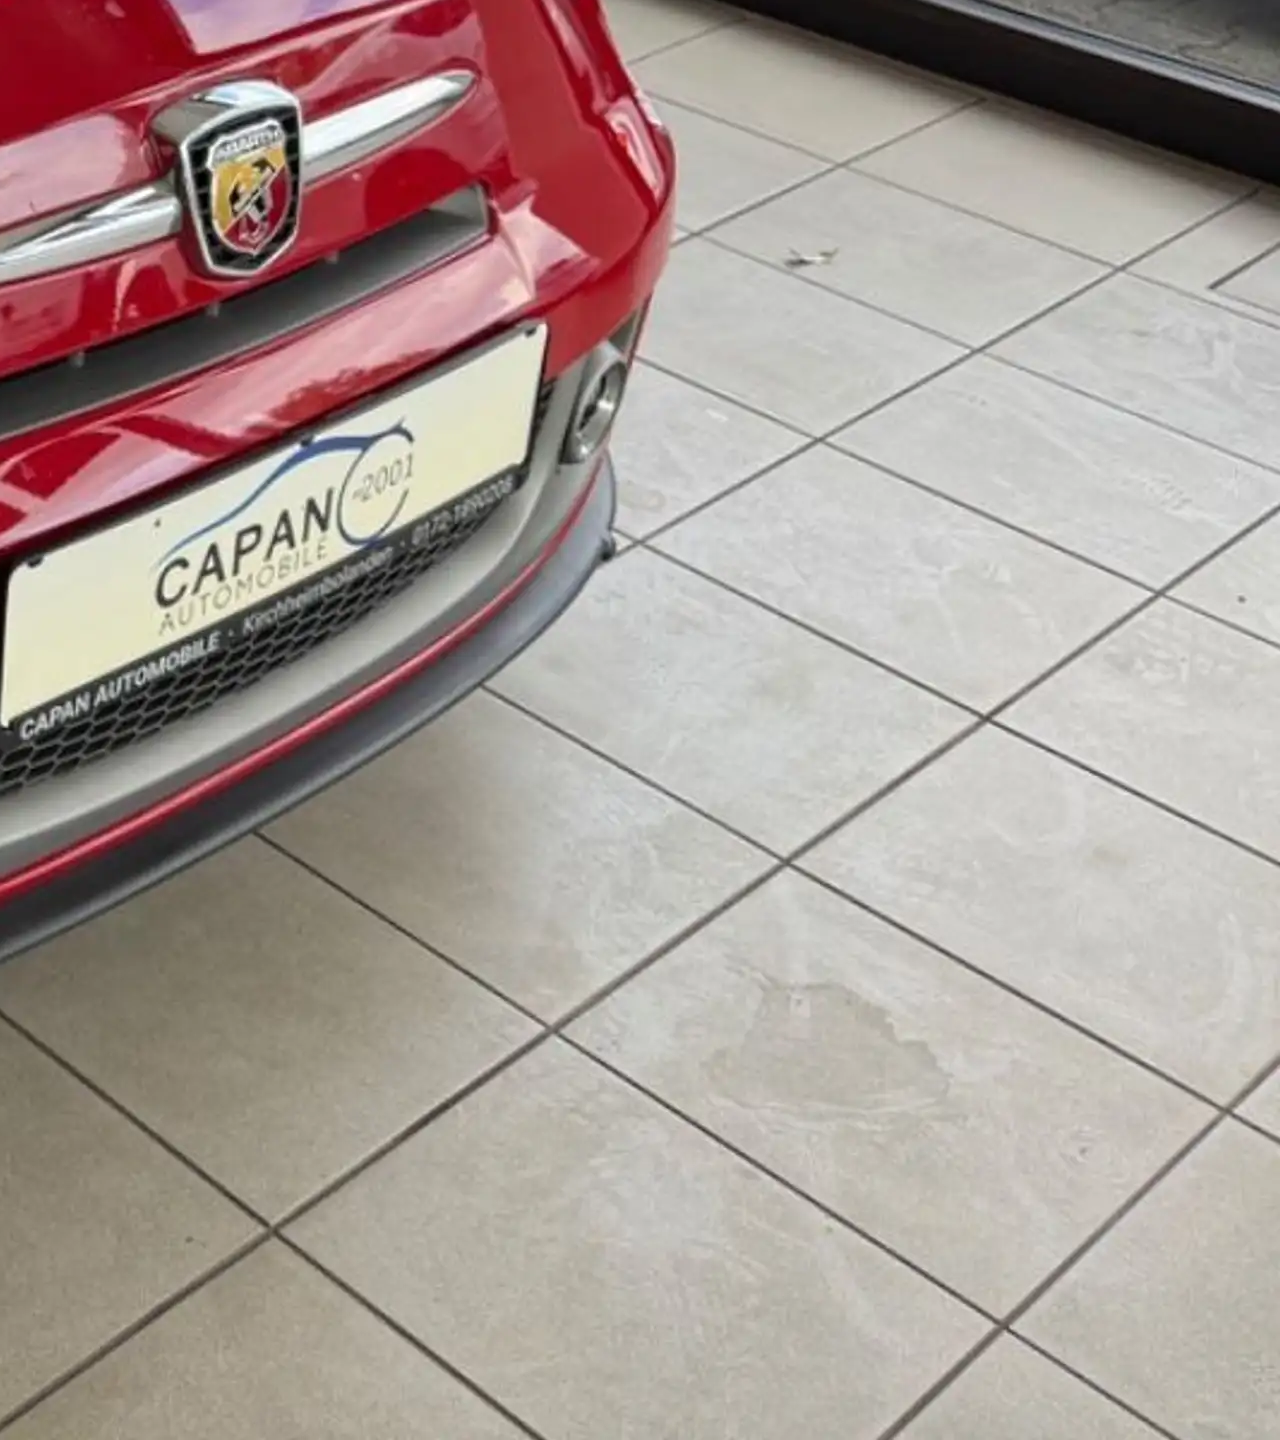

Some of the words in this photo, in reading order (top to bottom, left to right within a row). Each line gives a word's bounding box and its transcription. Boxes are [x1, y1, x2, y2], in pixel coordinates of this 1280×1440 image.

[155, 487, 333, 609] CAPAN
[159, 536, 328, 636] AUTOMOBILE
[20, 692, 91, 740] CAPAN
[94, 630, 221, 706] AUTOMOBILE
